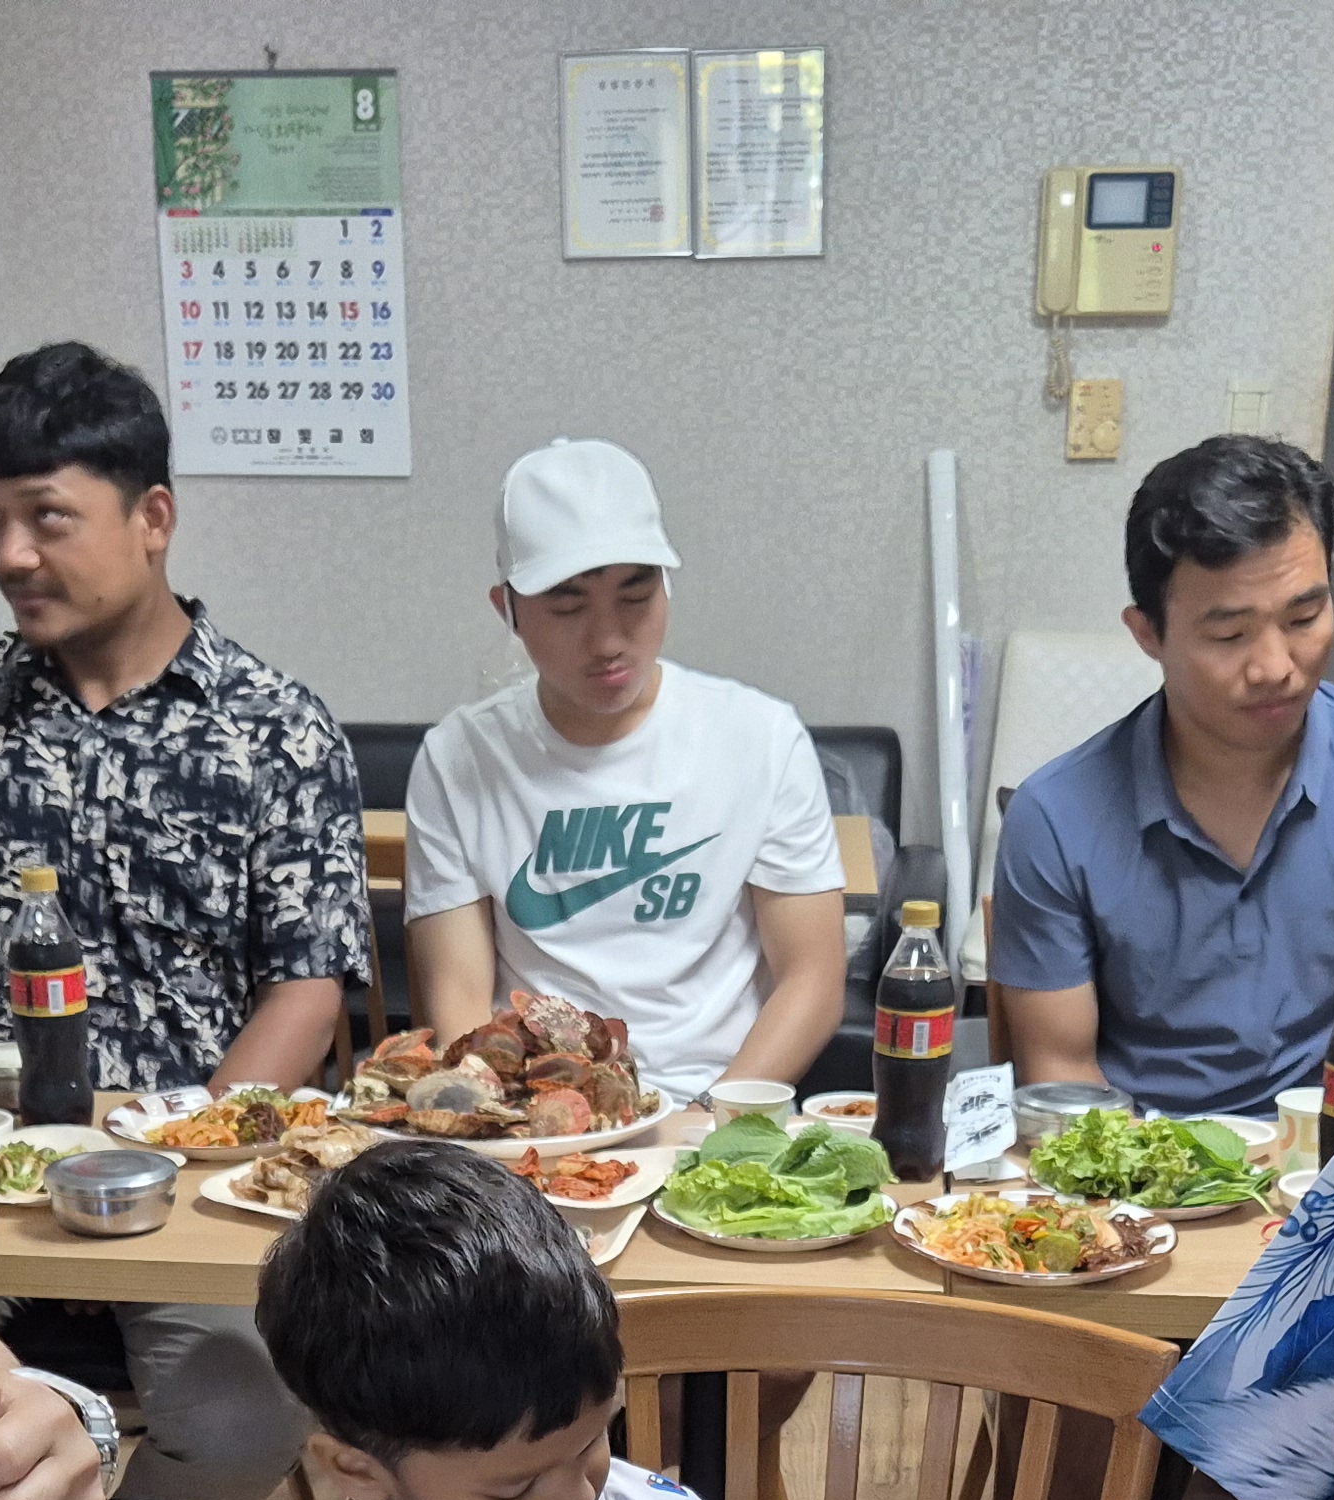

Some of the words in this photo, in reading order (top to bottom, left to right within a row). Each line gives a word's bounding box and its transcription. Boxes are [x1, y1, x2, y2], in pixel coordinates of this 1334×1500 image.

[356, 88, 374, 121] 8
[340, 220, 348, 238] 1
[371, 220, 382, 238] 2
[181, 261, 193, 279] 3
[213, 261, 225, 279] 4
[245, 261, 256, 279] 5
[277, 261, 290, 279] 6
[308, 261, 322, 279] 7
[340, 261, 353, 279] 8
[372, 261, 385, 279] 9
[180, 301, 201, 320] 10
[213, 301, 229, 320] 11
[244, 301, 264, 320] 12
[276, 301, 296, 320] 13
[307, 301, 328, 320] 14
[339, 301, 359, 320] 15
[370, 301, 391, 320] 16
[182, 341, 203, 360] 17
[214, 341, 235, 360] 18
[246, 341, 266, 360] 19
[275, 341, 299, 360] 20
[307, 341, 327, 360] 21
[338, 341, 362, 360] 22
[370, 341, 393, 360] 23
[215, 382, 237, 400] 25
[245, 382, 269, 400] 26
[277, 382, 301, 400] 27
[308, 382, 332, 400] 28
[340, 382, 363, 400] 29
[371, 382, 395, 400] 30
[534, 801, 673, 875] NIKE
[633, 873, 701, 923] SB
